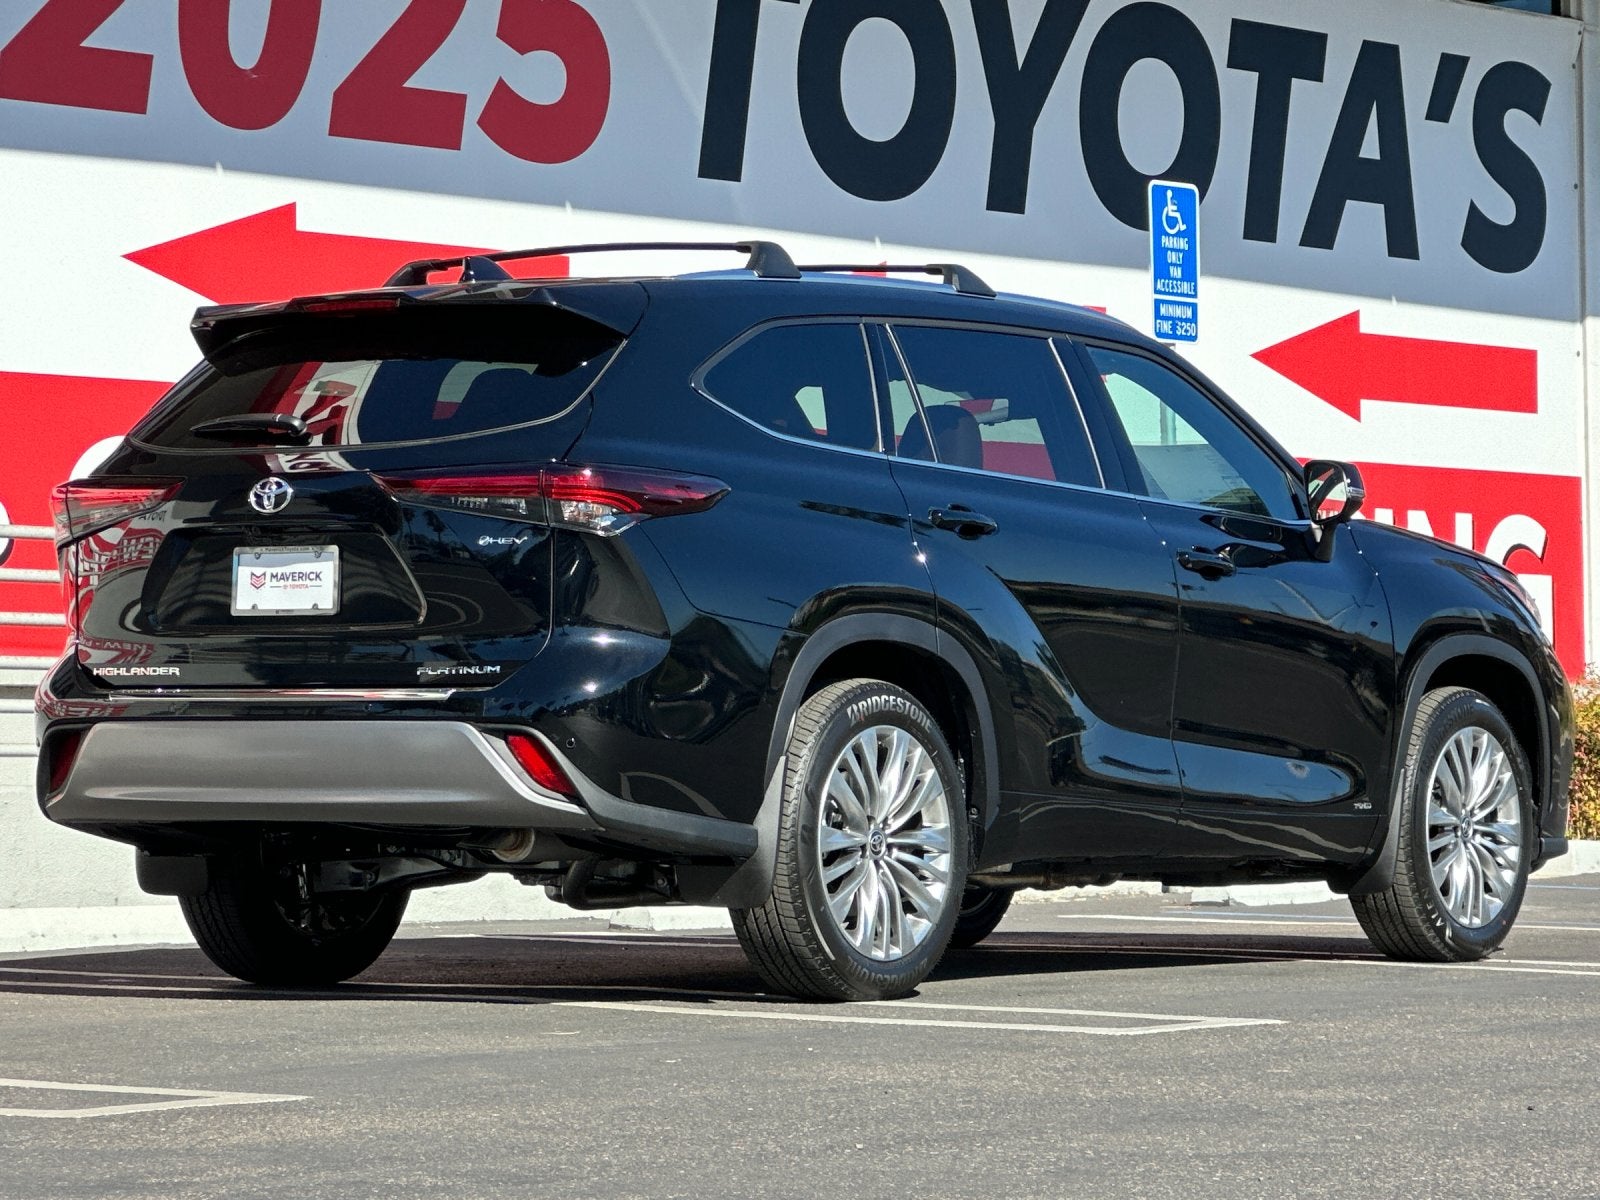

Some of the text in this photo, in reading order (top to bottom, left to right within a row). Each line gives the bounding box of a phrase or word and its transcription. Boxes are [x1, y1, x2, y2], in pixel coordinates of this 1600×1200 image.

[699, 0, 1552, 274] TOYOTA'S
[1161, 235, 1189, 251] PARKING
[1167, 250, 1184, 265] ONLY
[1169, 265, 1182, 279] VAN
[1156, 278, 1195, 295] ACCESSIBLE
[1160, 303, 1193, 319] MINIMUM
[1156, 319, 1196, 337] FINE $250
[270, 571, 322, 582] MAVERICK
[93, 667, 180, 676] HIGHLANDER
[416, 665, 501, 675] PLATINUM
[846, 694, 933, 733] BRIDGESTONE
